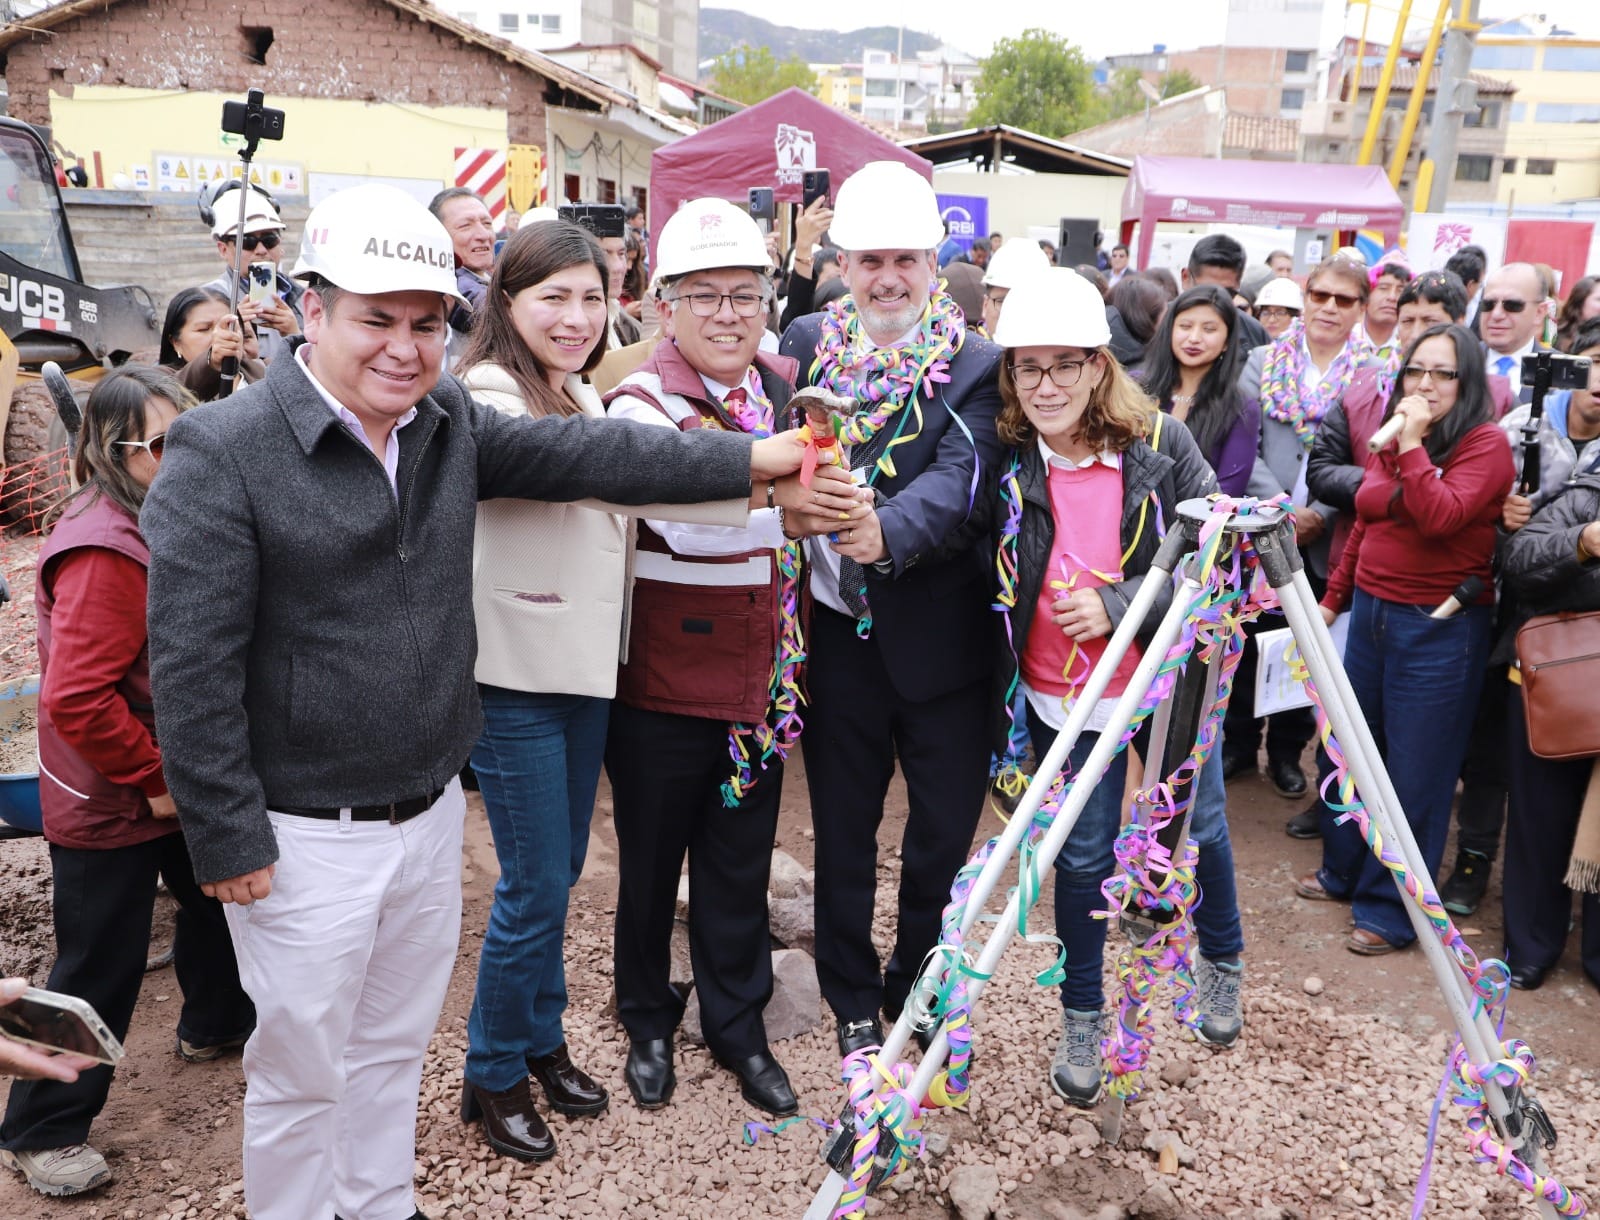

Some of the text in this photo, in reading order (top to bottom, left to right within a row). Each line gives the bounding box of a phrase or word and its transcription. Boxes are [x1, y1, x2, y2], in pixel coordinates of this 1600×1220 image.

[363, 237, 454, 271] ALCALDE
[689, 241, 738, 252] GOBERNADOR
[0, 275, 66, 322] JCB
